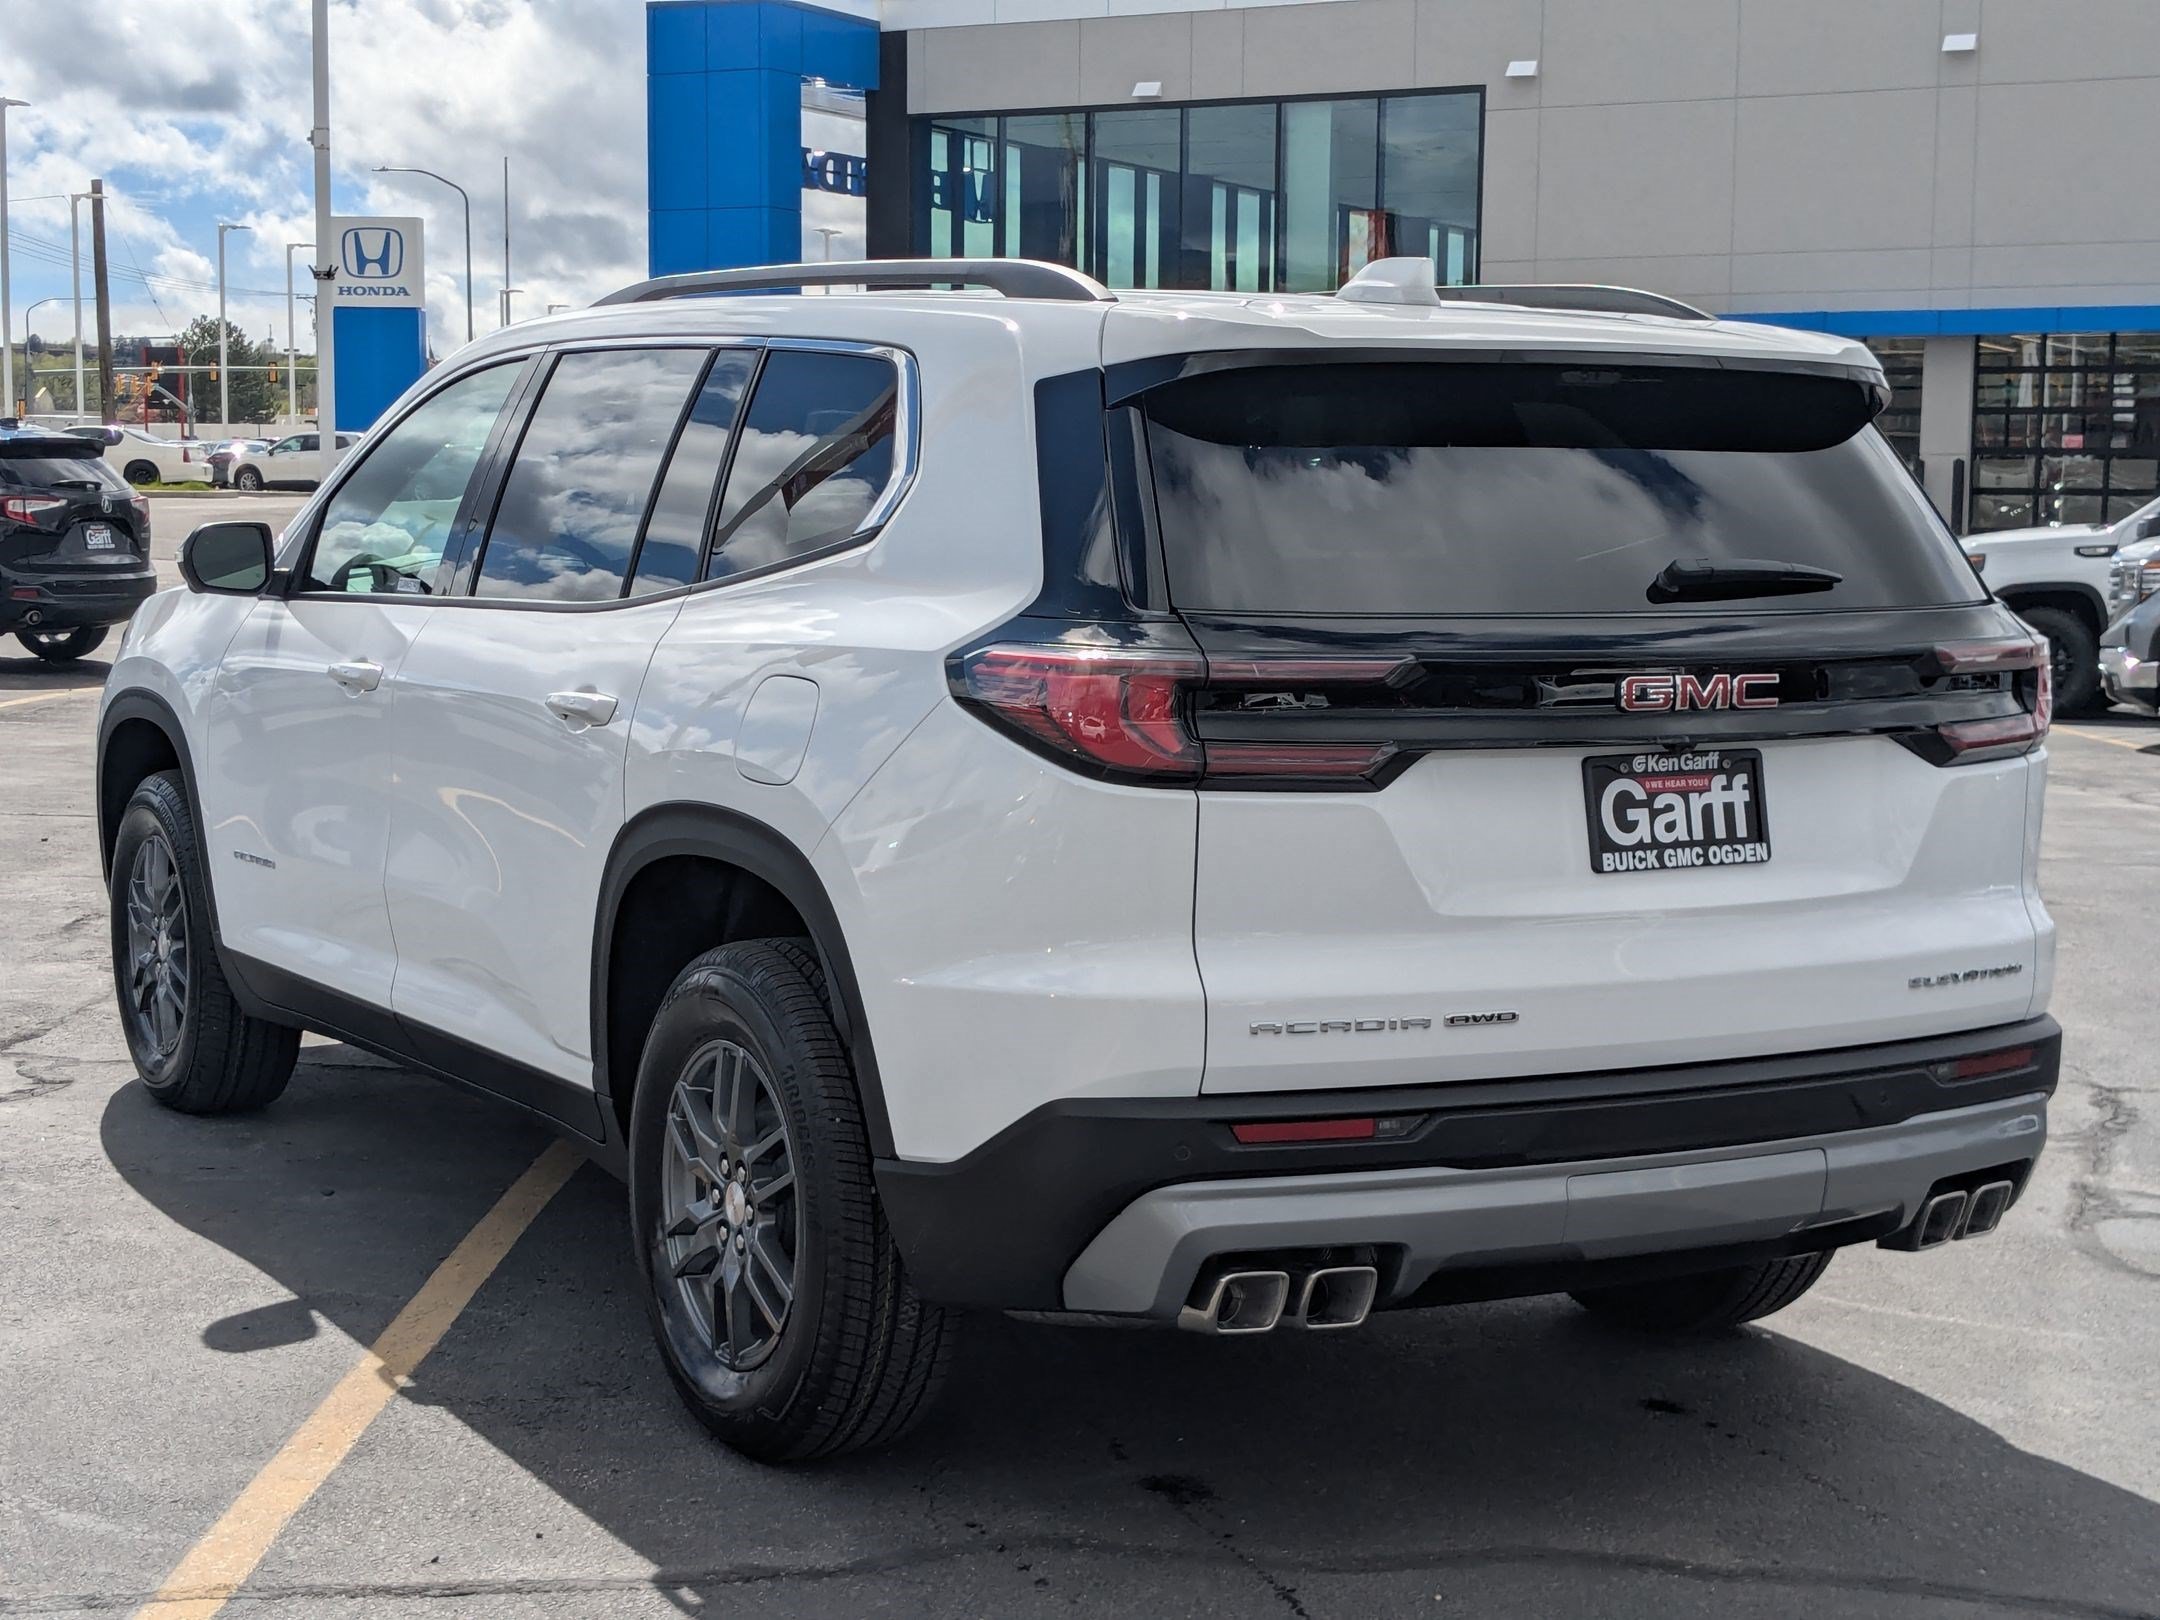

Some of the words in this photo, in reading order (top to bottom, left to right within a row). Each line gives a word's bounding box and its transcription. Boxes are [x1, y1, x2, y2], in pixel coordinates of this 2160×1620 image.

[337, 286, 410, 296] HONDA
[1620, 674, 1779, 711] GMC
[1647, 754, 1679, 772] Ken
[1680, 752, 1719, 771] Garff
[1651, 780, 1664, 789] WE
[1665, 778, 1687, 788] HEAR
[1688, 778, 1705, 787] YOU
[1601, 773, 1750, 846] Garff
[1602, 850, 1660, 872] BUICK
[1663, 846, 1704, 868] GMC
[1708, 842, 1769, 863] OGDEN
[1249, 1015, 1432, 1035] ACADIA
[1446, 1010, 1519, 1026] AWD
